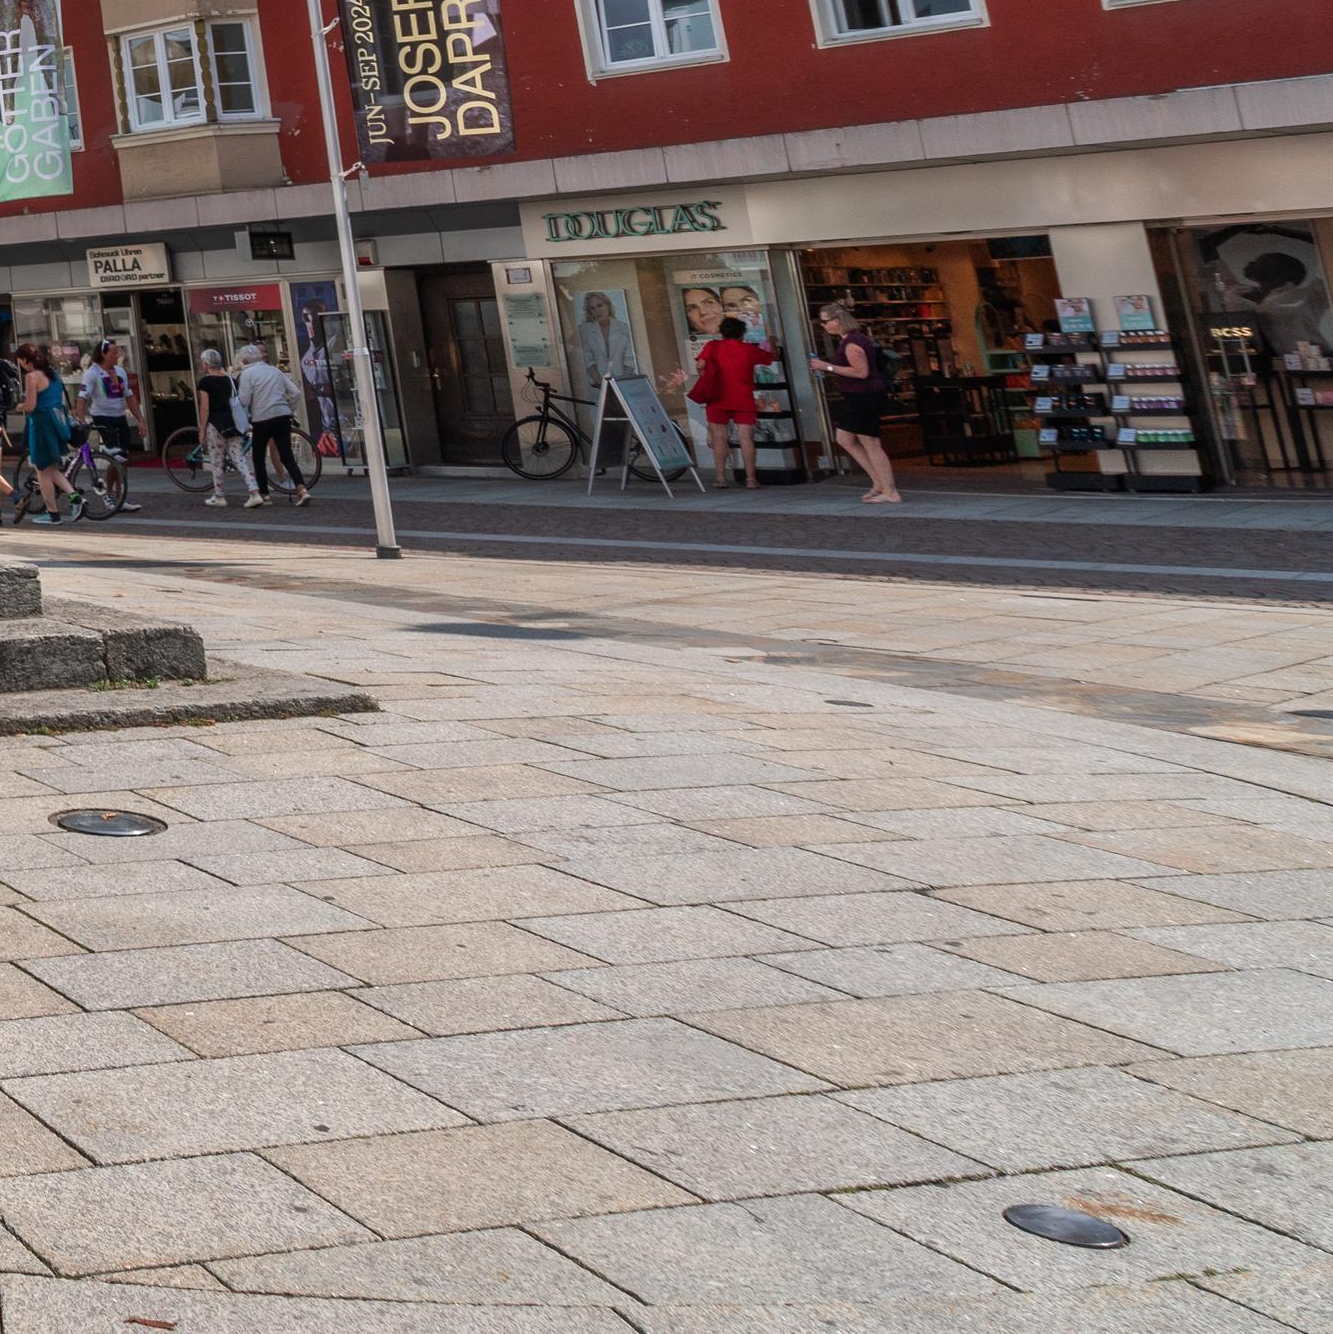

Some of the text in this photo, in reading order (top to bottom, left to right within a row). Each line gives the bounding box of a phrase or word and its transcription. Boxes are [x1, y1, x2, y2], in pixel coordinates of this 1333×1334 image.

[28, 44, 63, 180] GABEN
[542, 201, 719, 243] DOUGLAS
[93, 258, 142, 274] PALLA
[699, 271, 743, 280] COSMETICS
[224, 293, 257, 302] TISSOT
